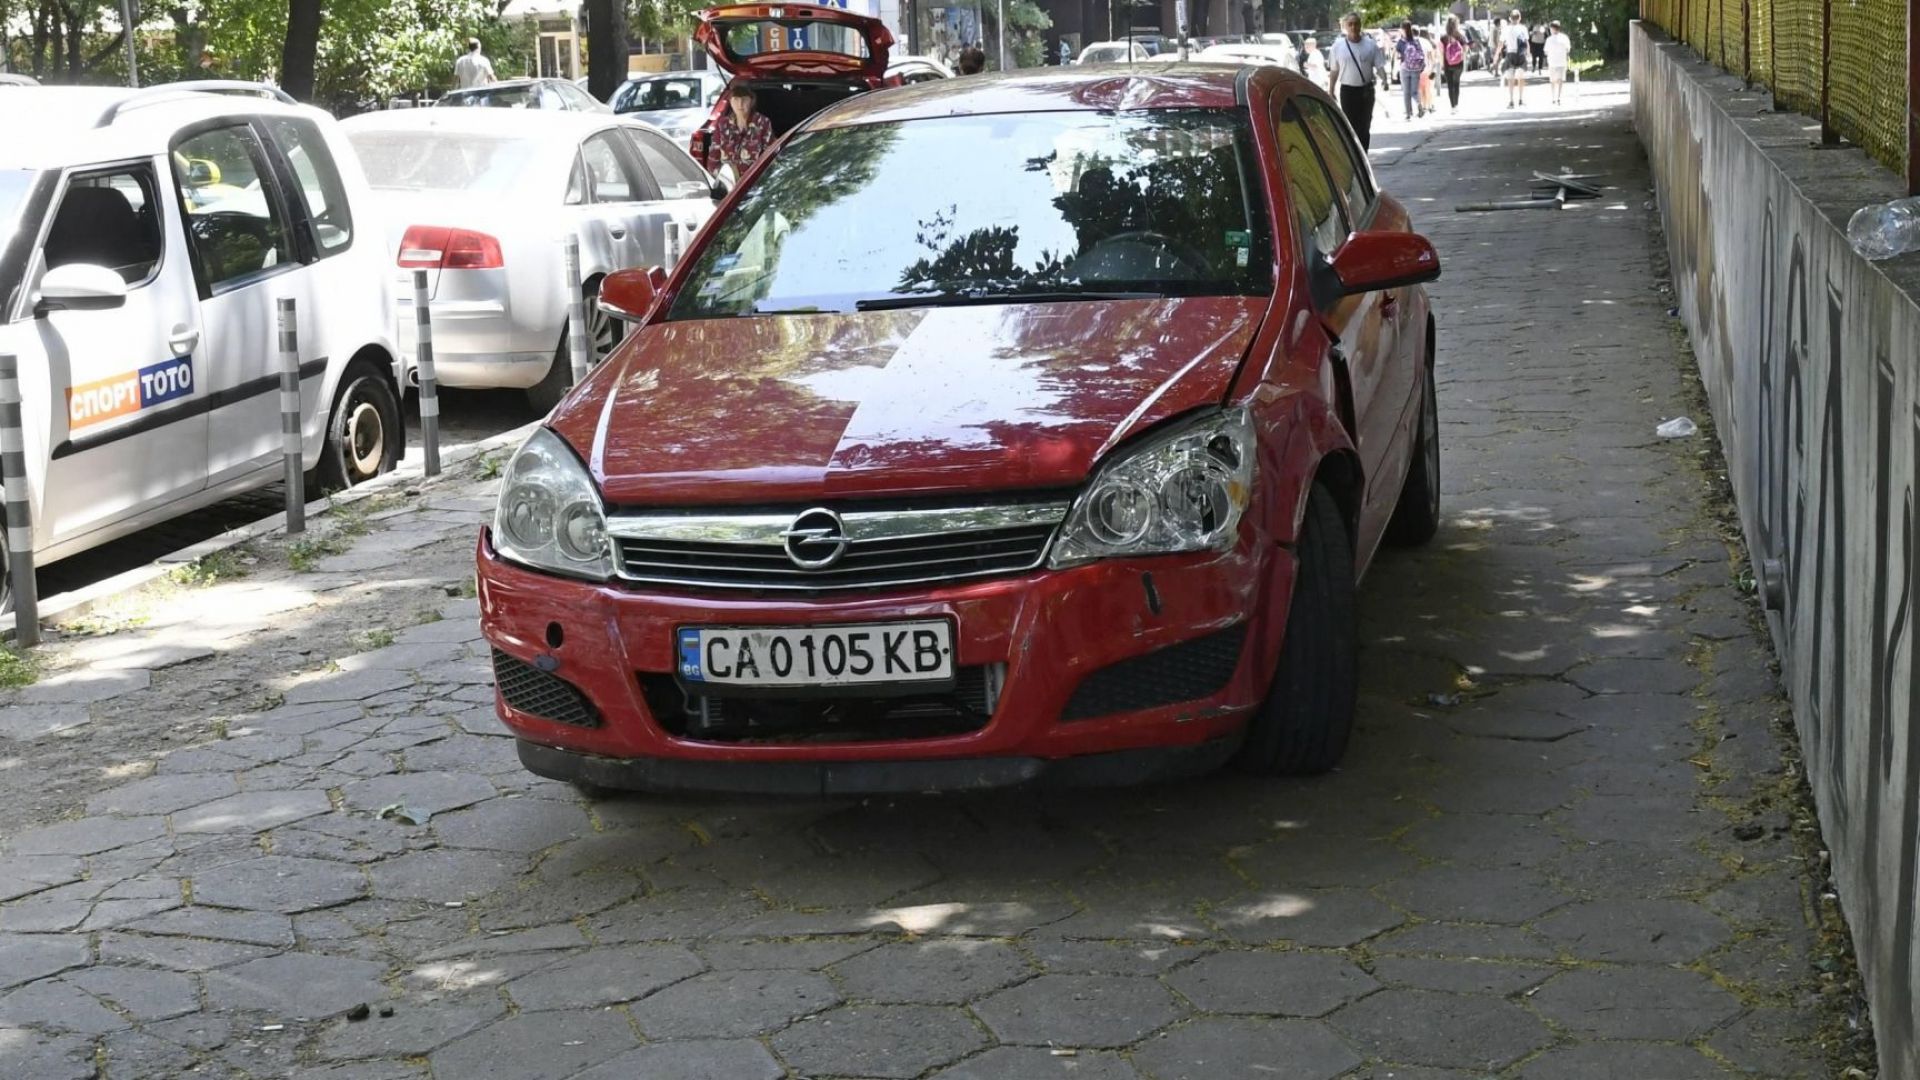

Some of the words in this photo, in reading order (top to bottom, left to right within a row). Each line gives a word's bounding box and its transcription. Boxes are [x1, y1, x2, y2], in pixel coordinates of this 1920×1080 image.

[770, 28, 780, 51] СП
[71, 379, 138, 421] СПОРТ
[141, 363, 191, 400] ТОТО
[683, 664, 700, 675] BG
